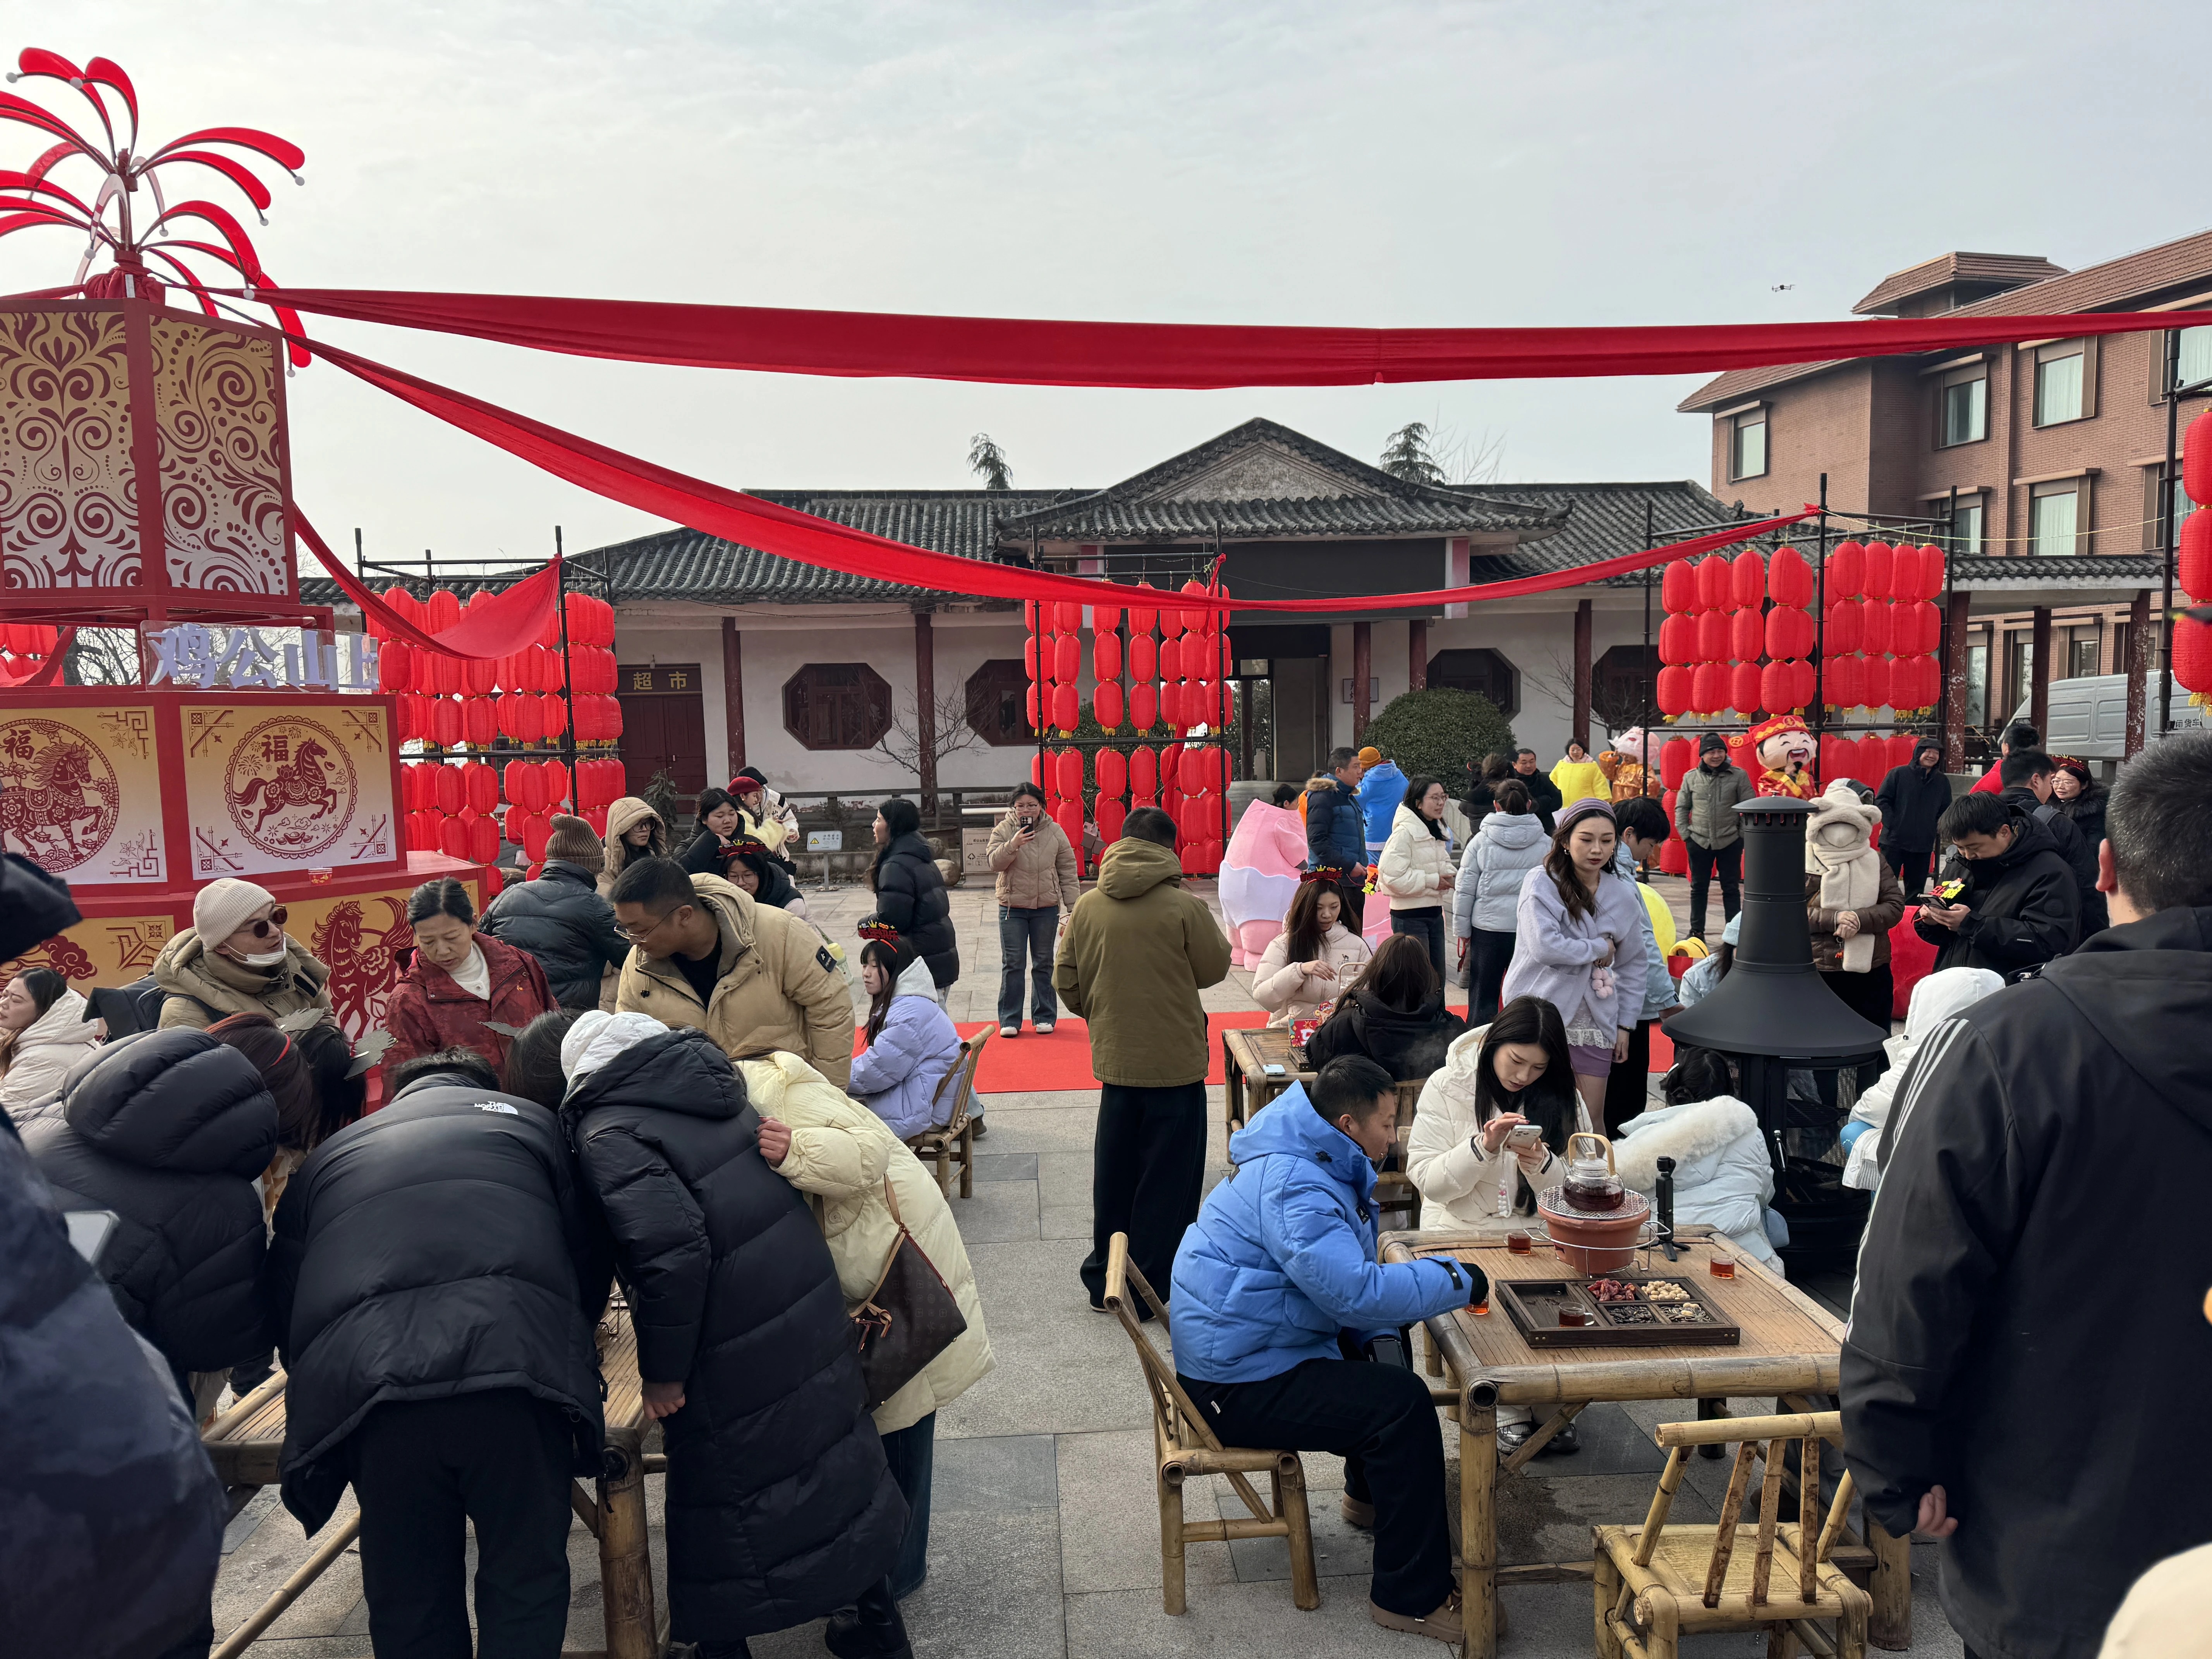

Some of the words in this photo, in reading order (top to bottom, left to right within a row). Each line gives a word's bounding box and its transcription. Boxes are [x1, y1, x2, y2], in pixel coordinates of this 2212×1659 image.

[634, 671, 687, 690] 超市
[2173, 718, 2199, 728] 闭货车
[3, 729, 35, 760] 福
[261, 734, 289, 763] 福
